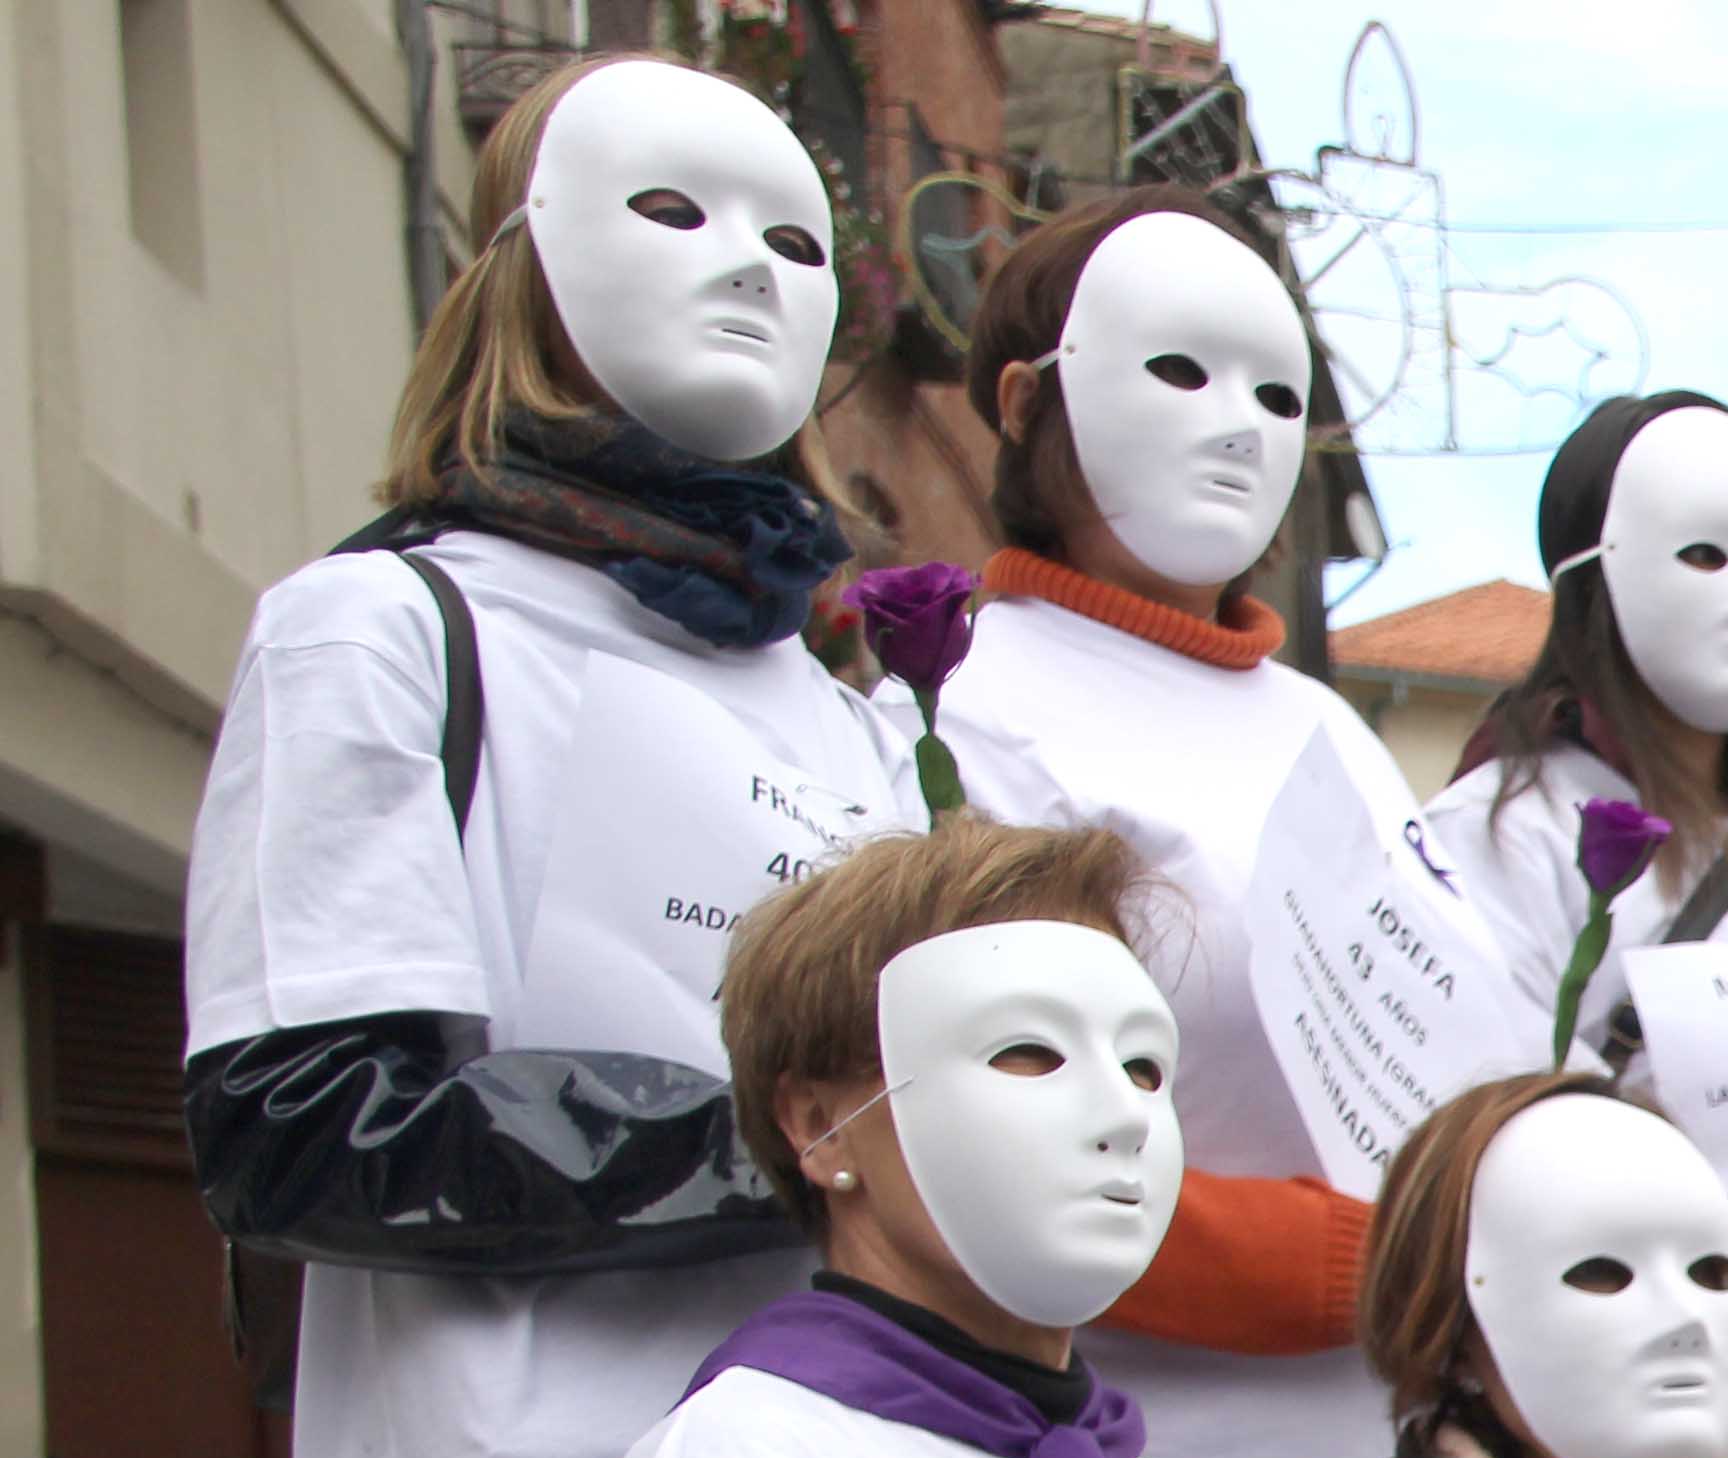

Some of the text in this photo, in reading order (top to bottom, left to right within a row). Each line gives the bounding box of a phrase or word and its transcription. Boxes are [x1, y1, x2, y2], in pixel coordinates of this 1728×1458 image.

[1347, 941, 1375, 981] 43
[1367, 897, 1457, 1001] JOSEFA
[1378, 991, 1429, 1047] AÑOS
